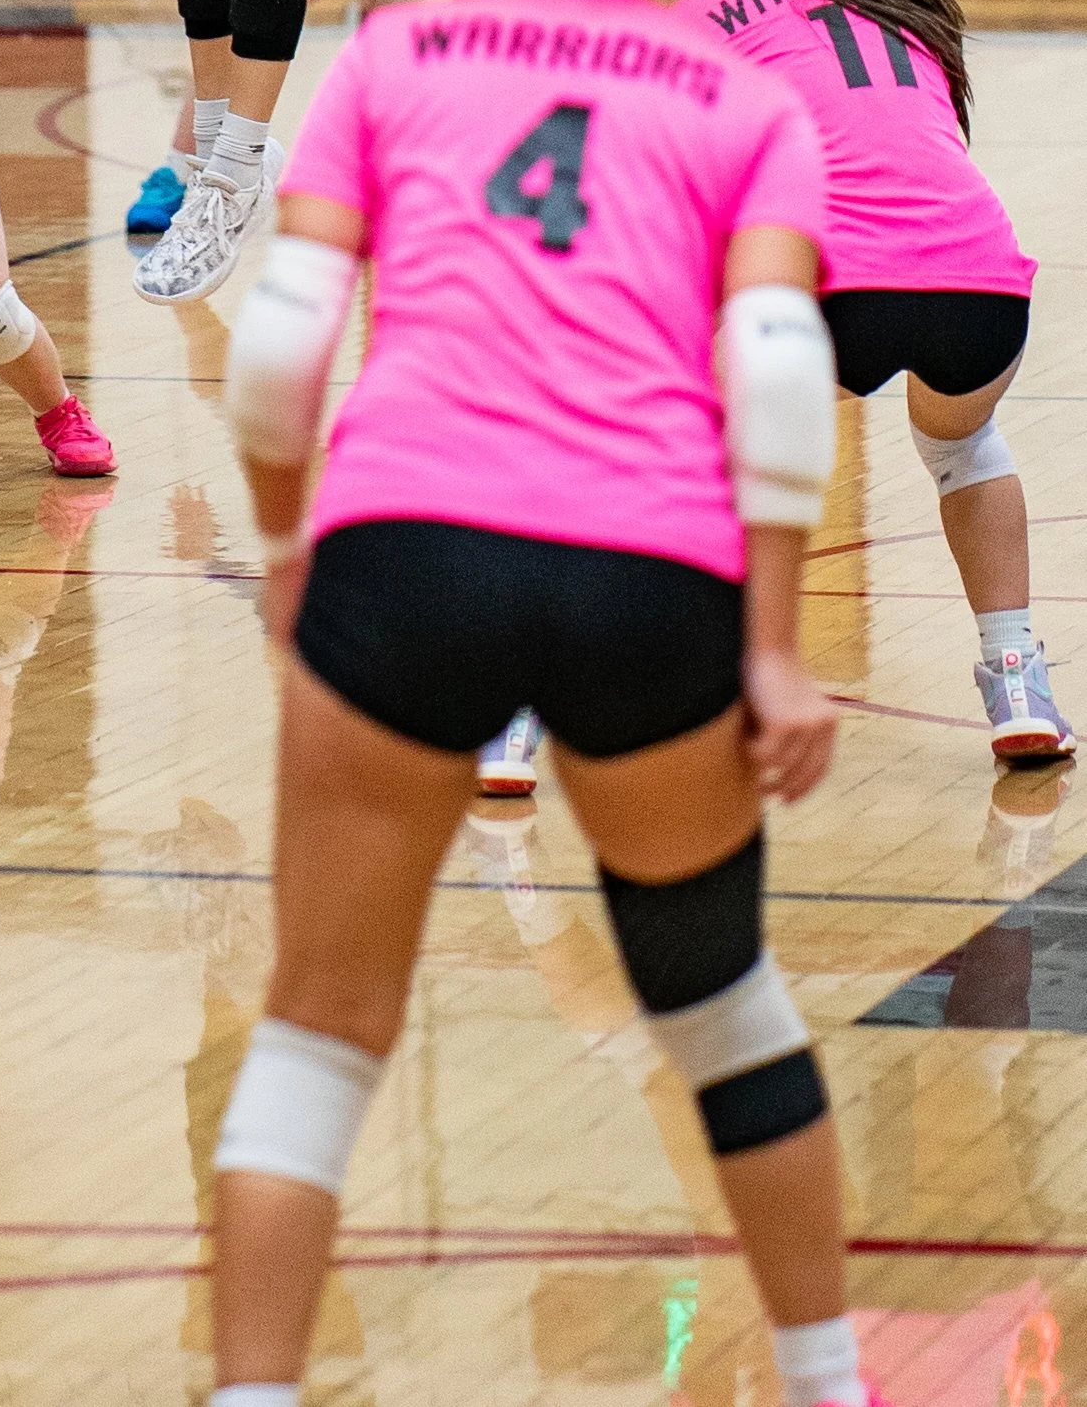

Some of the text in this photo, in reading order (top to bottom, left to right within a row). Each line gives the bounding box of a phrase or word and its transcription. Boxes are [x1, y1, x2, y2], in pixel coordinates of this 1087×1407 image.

[411, 16, 726, 106] WARRIORS
[806, 2, 919, 90] 11
[484, 100, 593, 254] 4
